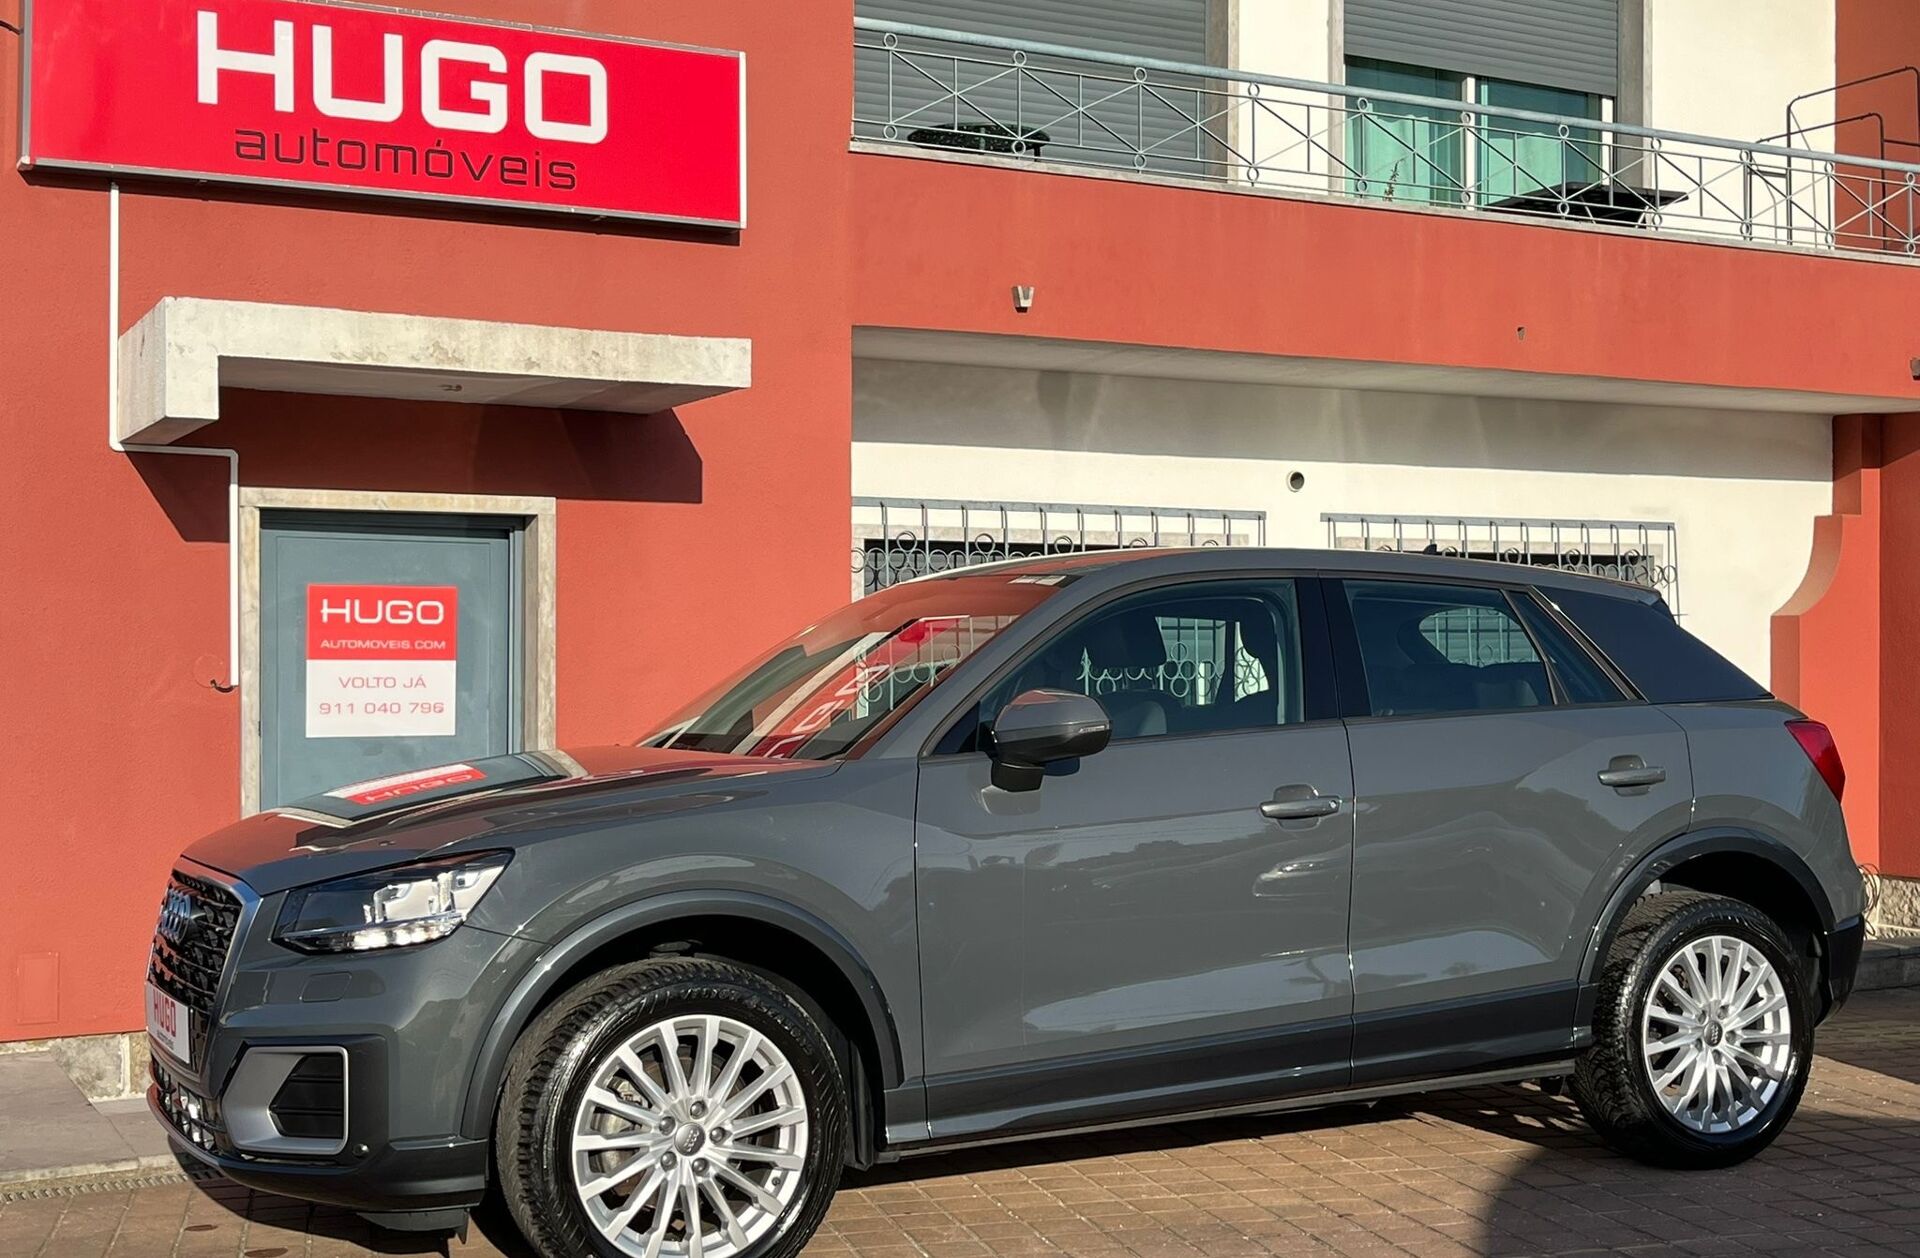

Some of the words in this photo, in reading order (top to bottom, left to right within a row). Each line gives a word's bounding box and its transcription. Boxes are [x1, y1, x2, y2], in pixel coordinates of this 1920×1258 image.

[197, 10, 608, 145] HUGO
[235, 127, 577, 190] automóveis
[320, 598, 445, 624] HUGO
[320, 639, 446, 650] AUTOMOVEIS.COM
[338, 676, 398, 689] VOLTO
[403, 674, 427, 689] JÁ
[319, 702, 355, 715] 911
[364, 702, 402, 715] 040
[409, 702, 445, 715] 796
[153, 988, 176, 1037] HUGO
